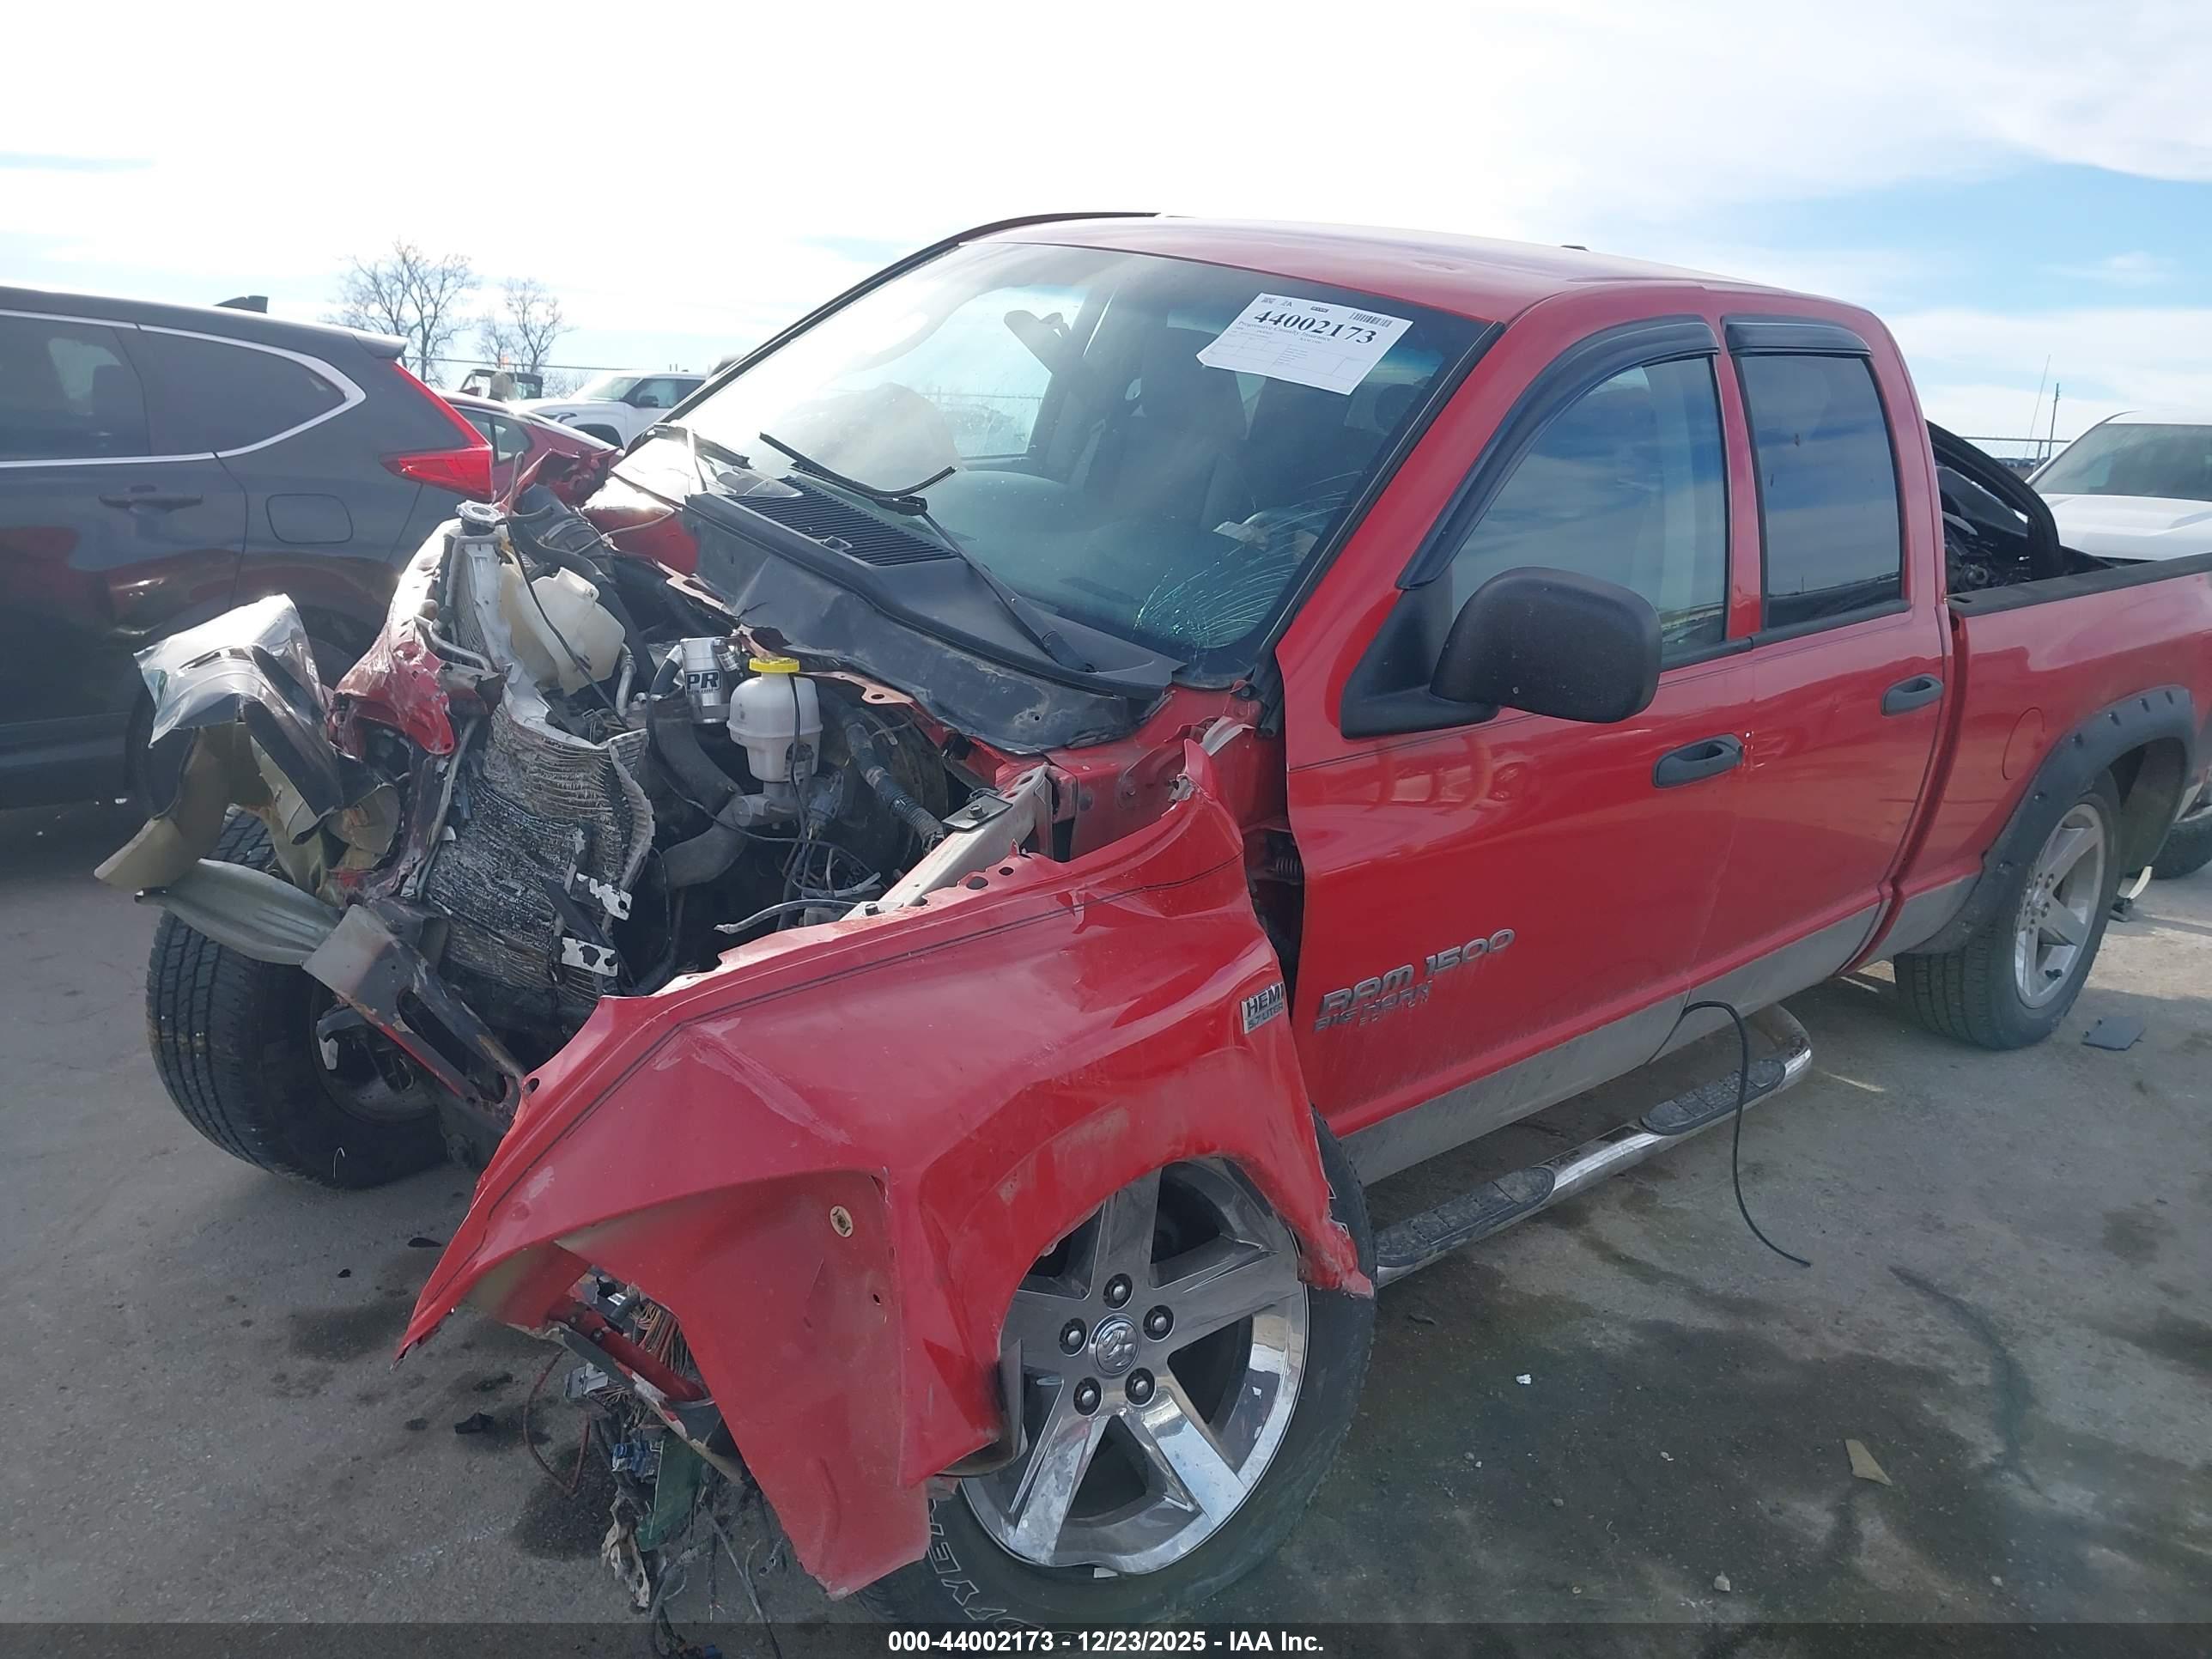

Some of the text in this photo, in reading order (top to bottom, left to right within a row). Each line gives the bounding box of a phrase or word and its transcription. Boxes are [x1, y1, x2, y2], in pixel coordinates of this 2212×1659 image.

[1254, 310, 1377, 344] 44002173
[1317, 928, 1516, 1018] RAM 1500
[1246, 983, 1285, 1018] HEMI
